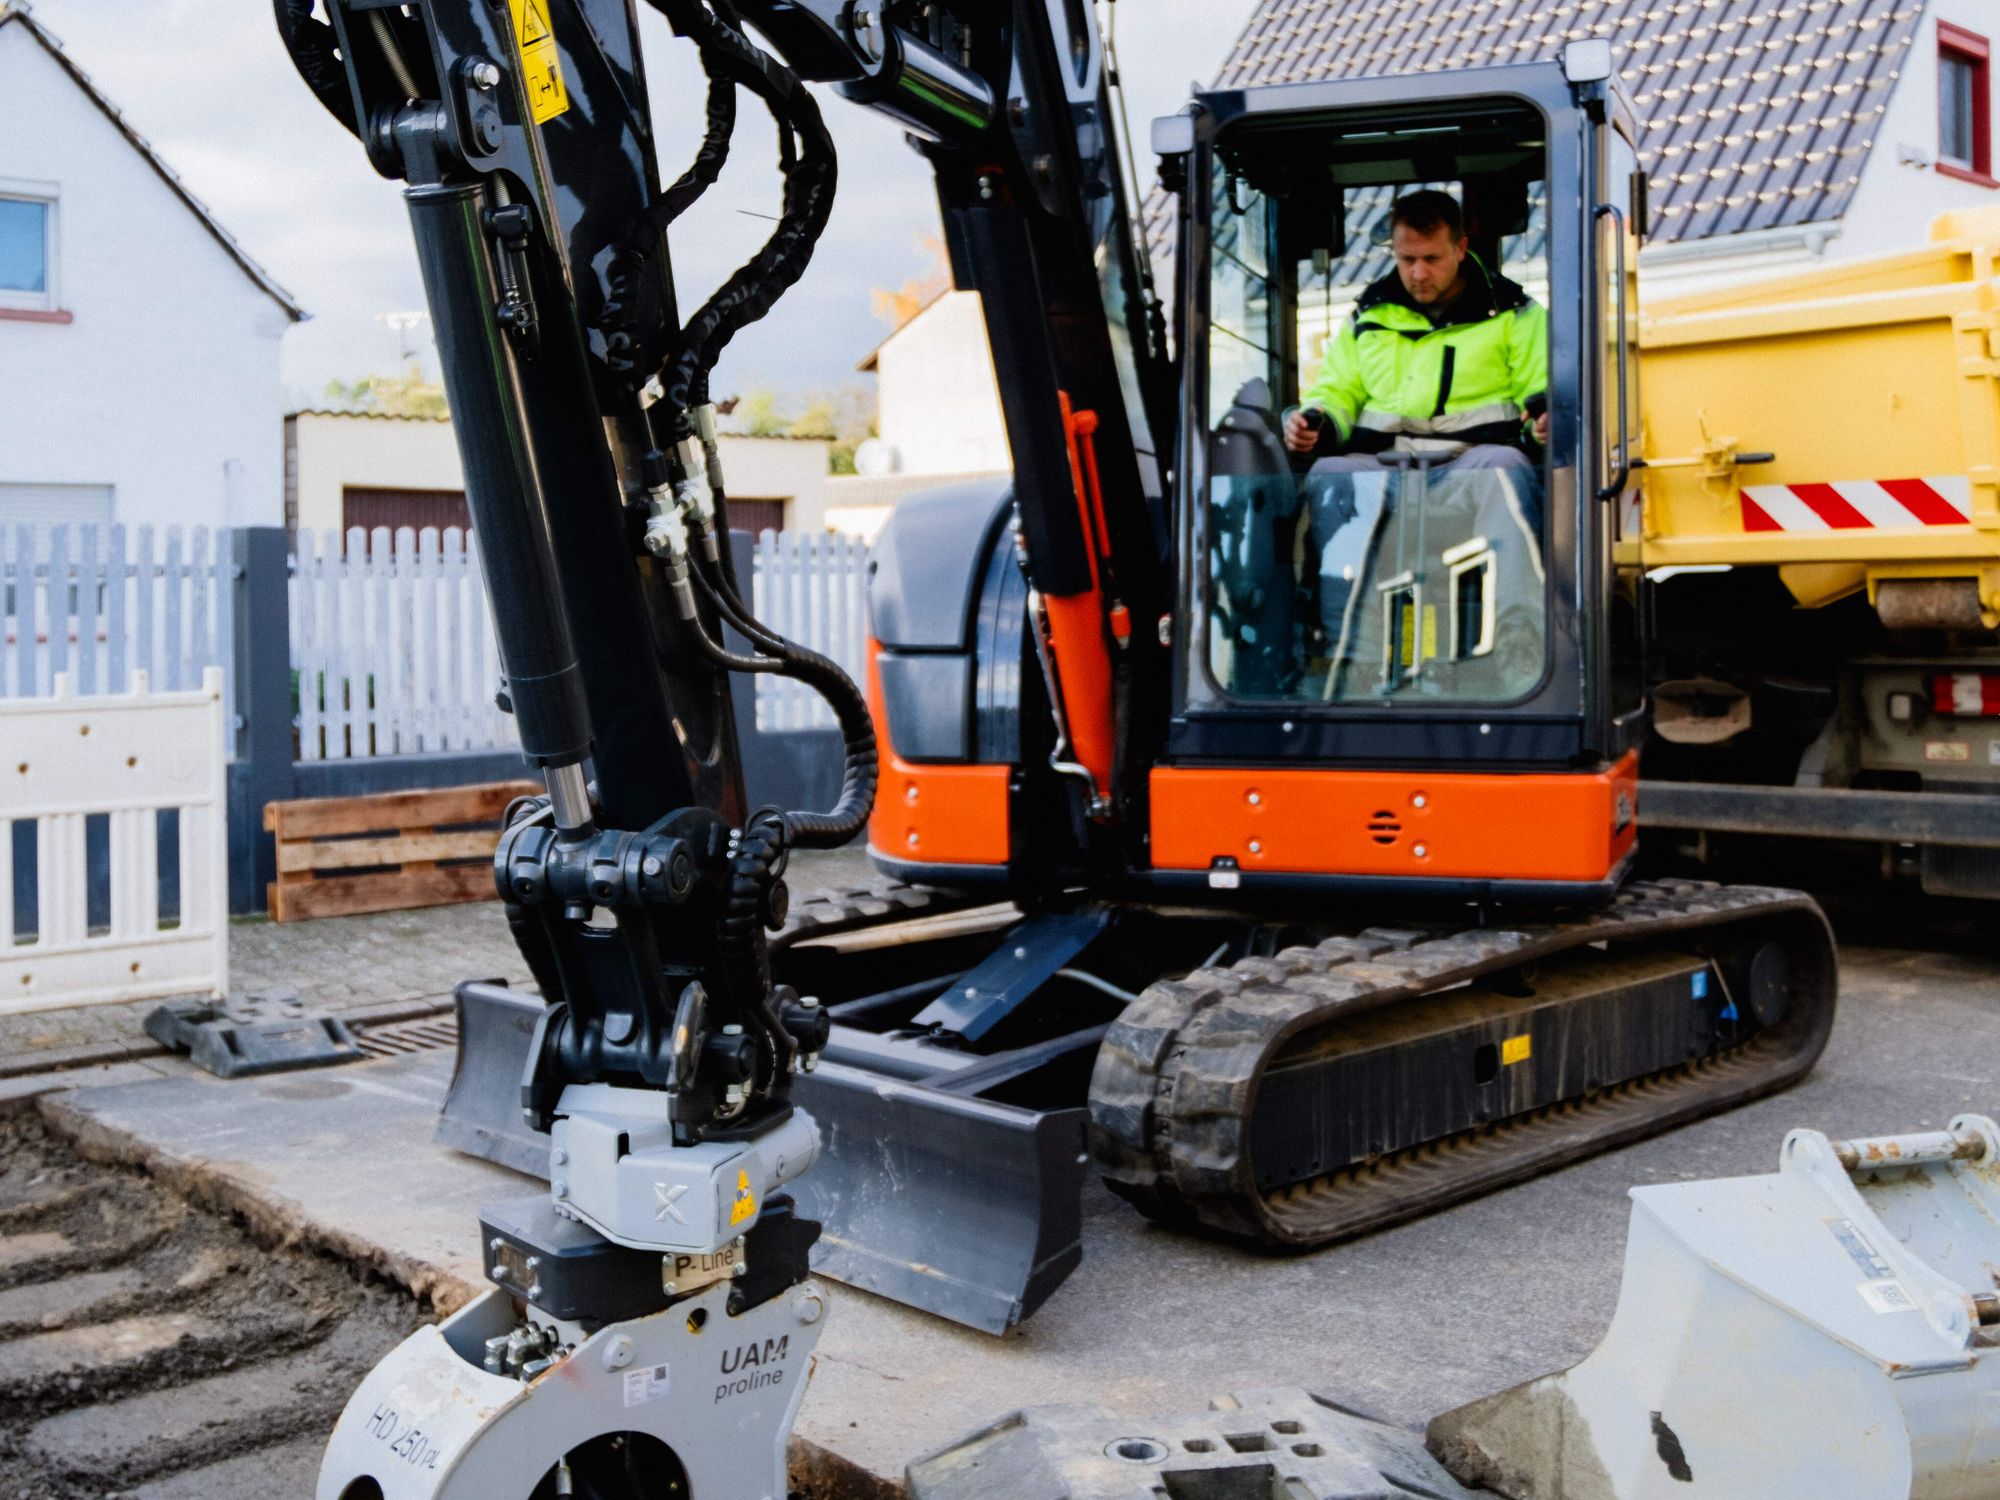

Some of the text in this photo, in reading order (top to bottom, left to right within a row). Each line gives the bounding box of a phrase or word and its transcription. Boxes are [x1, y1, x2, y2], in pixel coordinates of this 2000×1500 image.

[721, 1334, 789, 1375] UAM
[714, 1369, 784, 1405] proline
[364, 1402, 399, 1441] HD
